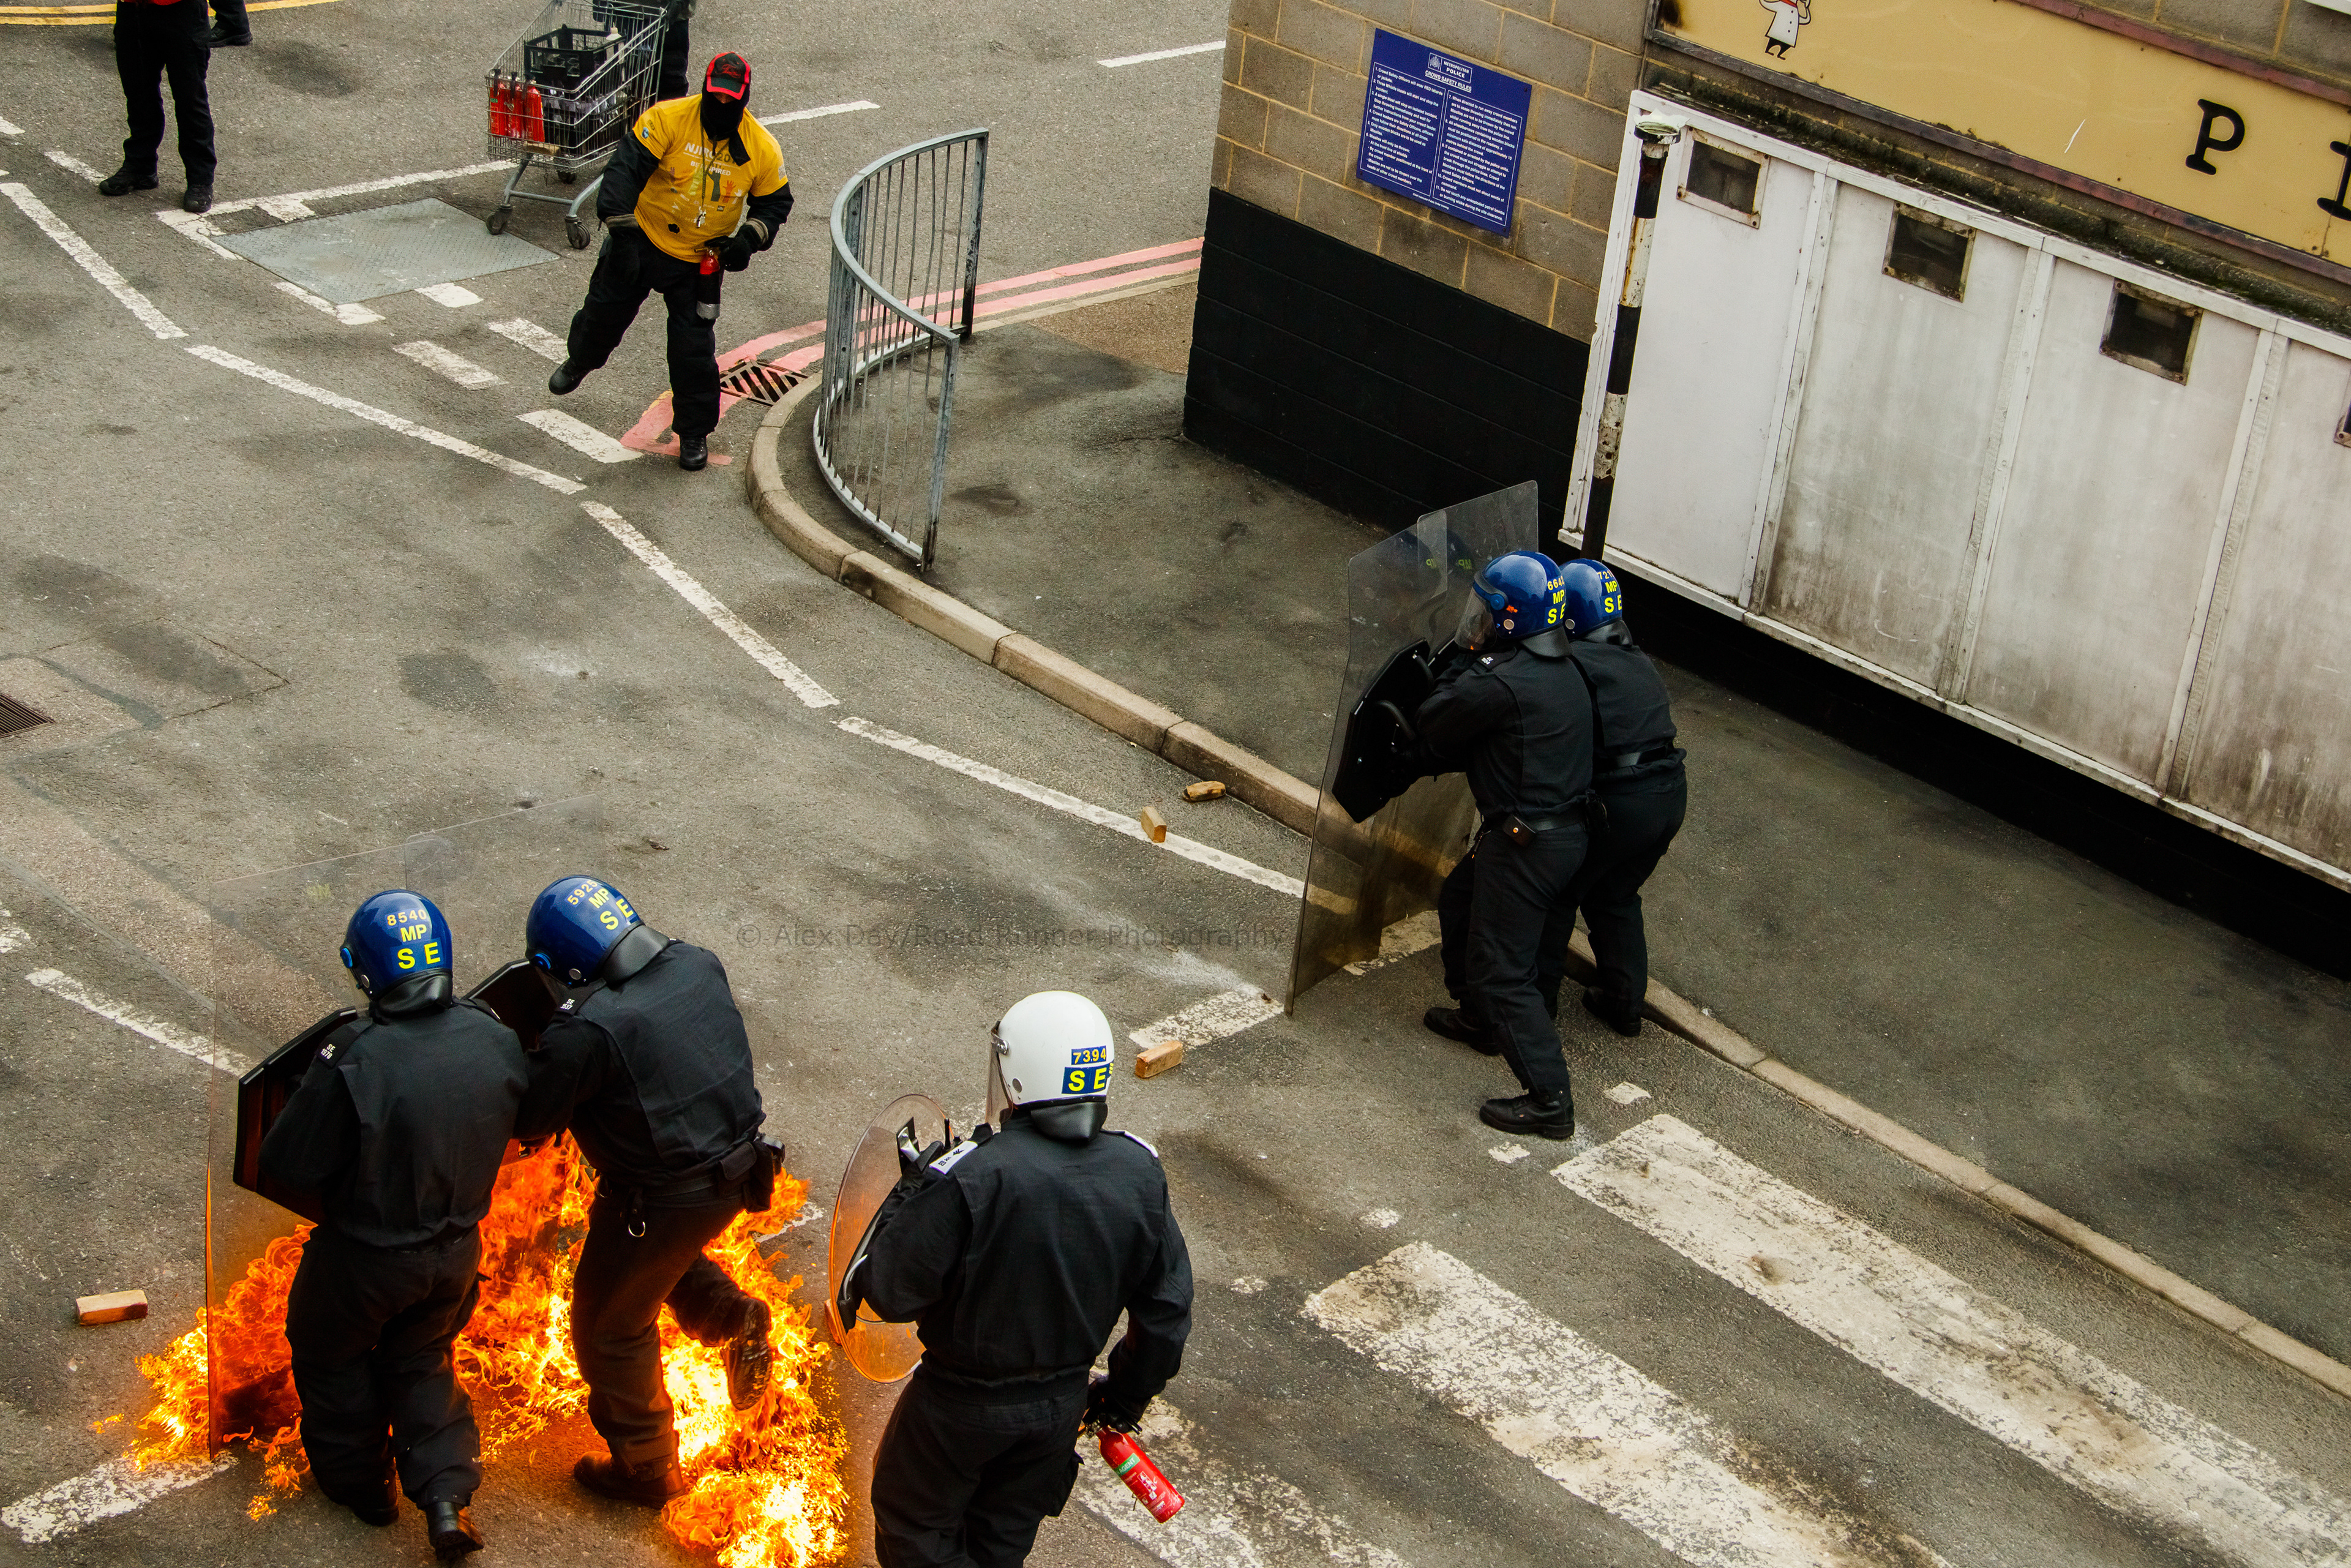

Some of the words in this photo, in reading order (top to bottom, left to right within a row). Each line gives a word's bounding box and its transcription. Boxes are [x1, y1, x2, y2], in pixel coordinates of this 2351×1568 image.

[1444, 61, 1469, 73] METROPOLITAN
[1446, 67, 1465, 78] POLICE
[1425, 70, 1441, 80] CROWD
[1441, 76, 1458, 86] SAFETY
[1458, 82, 1472, 92] RULES
[1547, 576, 1564, 590] 6642
[1605, 580, 1617, 593] MP
[1553, 590, 1564, 604] MP
[568, 880, 598, 905] 5925
[588, 888, 609, 909] MP
[387, 909, 427, 926] 8540
[400, 924, 427, 942] MP
[327, 1044, 336, 1052] SE
[1073, 1048, 1106, 1064] 7394
[1119, 1457, 1136, 1473] AGENT
